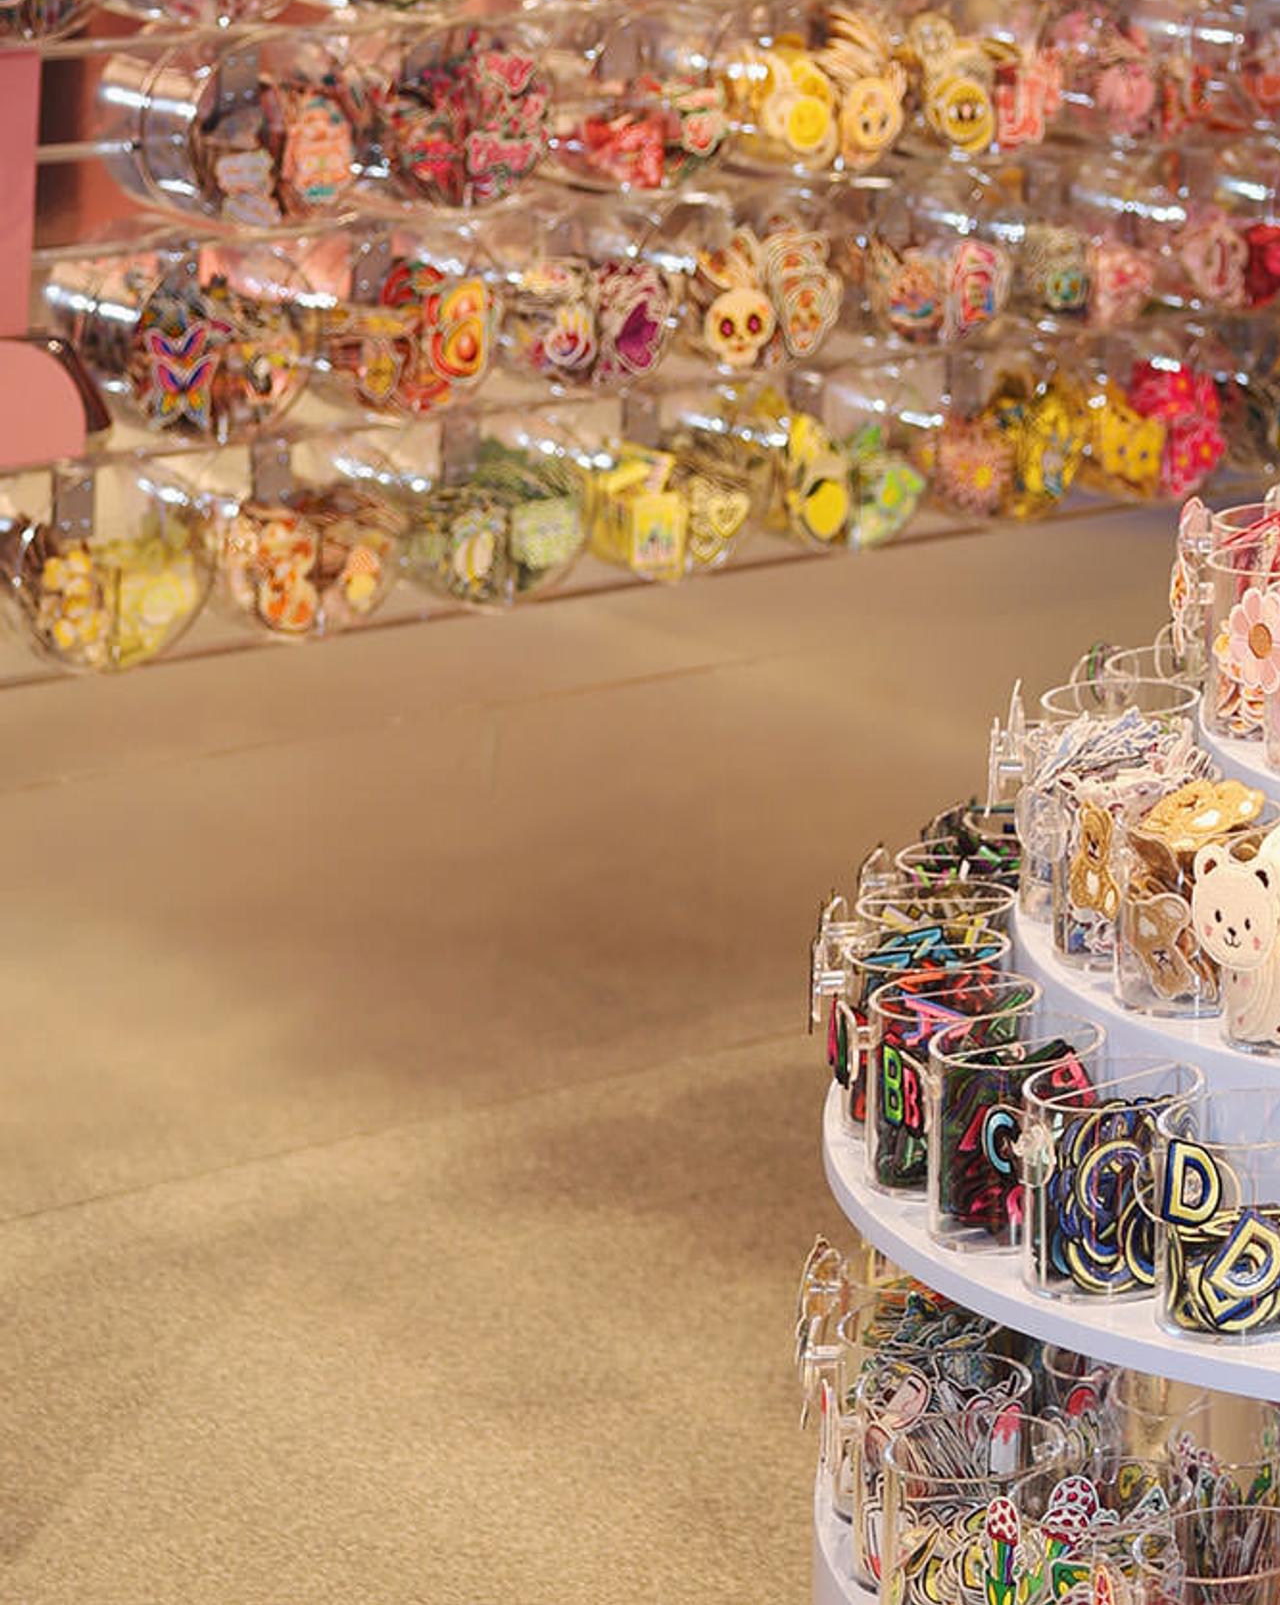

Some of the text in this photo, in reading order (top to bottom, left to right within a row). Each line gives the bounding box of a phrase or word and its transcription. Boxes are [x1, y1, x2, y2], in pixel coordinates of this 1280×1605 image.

[883, 1045, 903, 1126] B
[985, 1110, 1016, 1173] C
[1165, 1141, 1220, 1224] D
